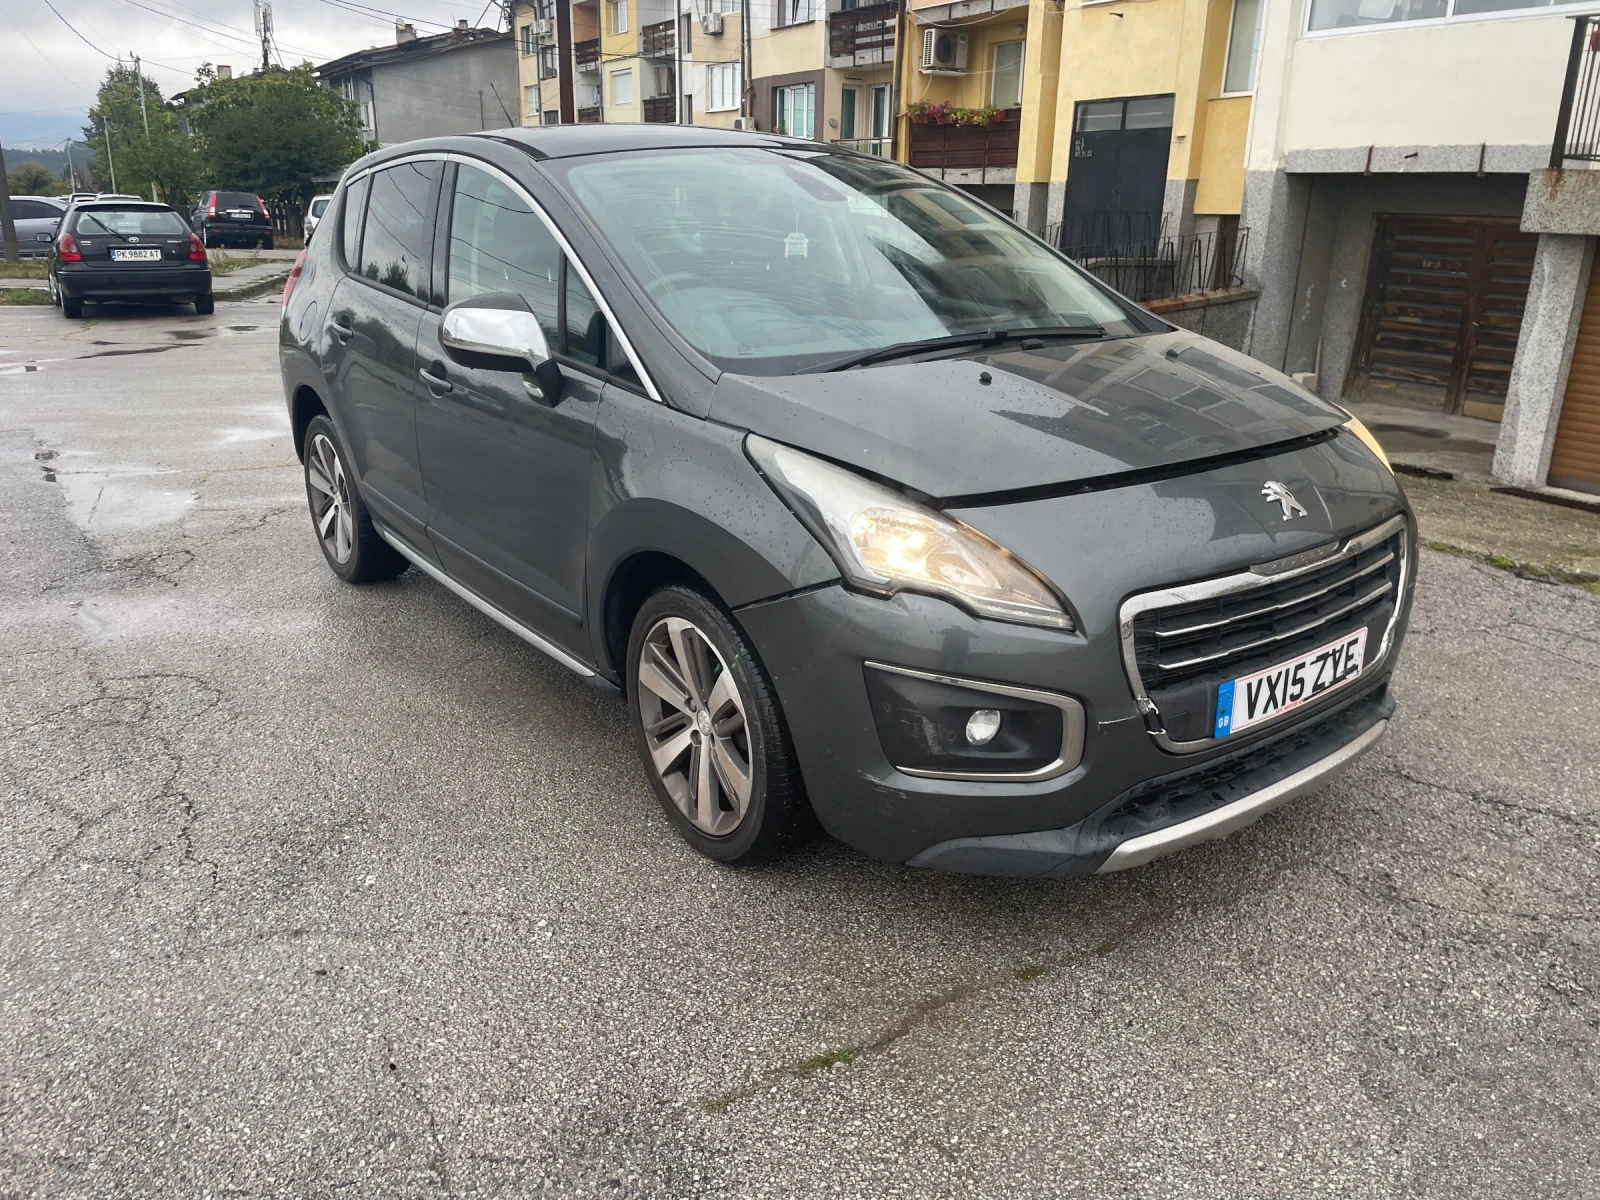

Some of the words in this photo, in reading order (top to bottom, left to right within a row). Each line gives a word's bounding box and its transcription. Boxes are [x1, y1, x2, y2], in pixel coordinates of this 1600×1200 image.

[116, 250, 127, 259] PK
[128, 250, 148, 259] 9882
[149, 250, 159, 259] AT
[1247, 662, 1307, 720] VX15
[1218, 715, 1230, 729] GB
